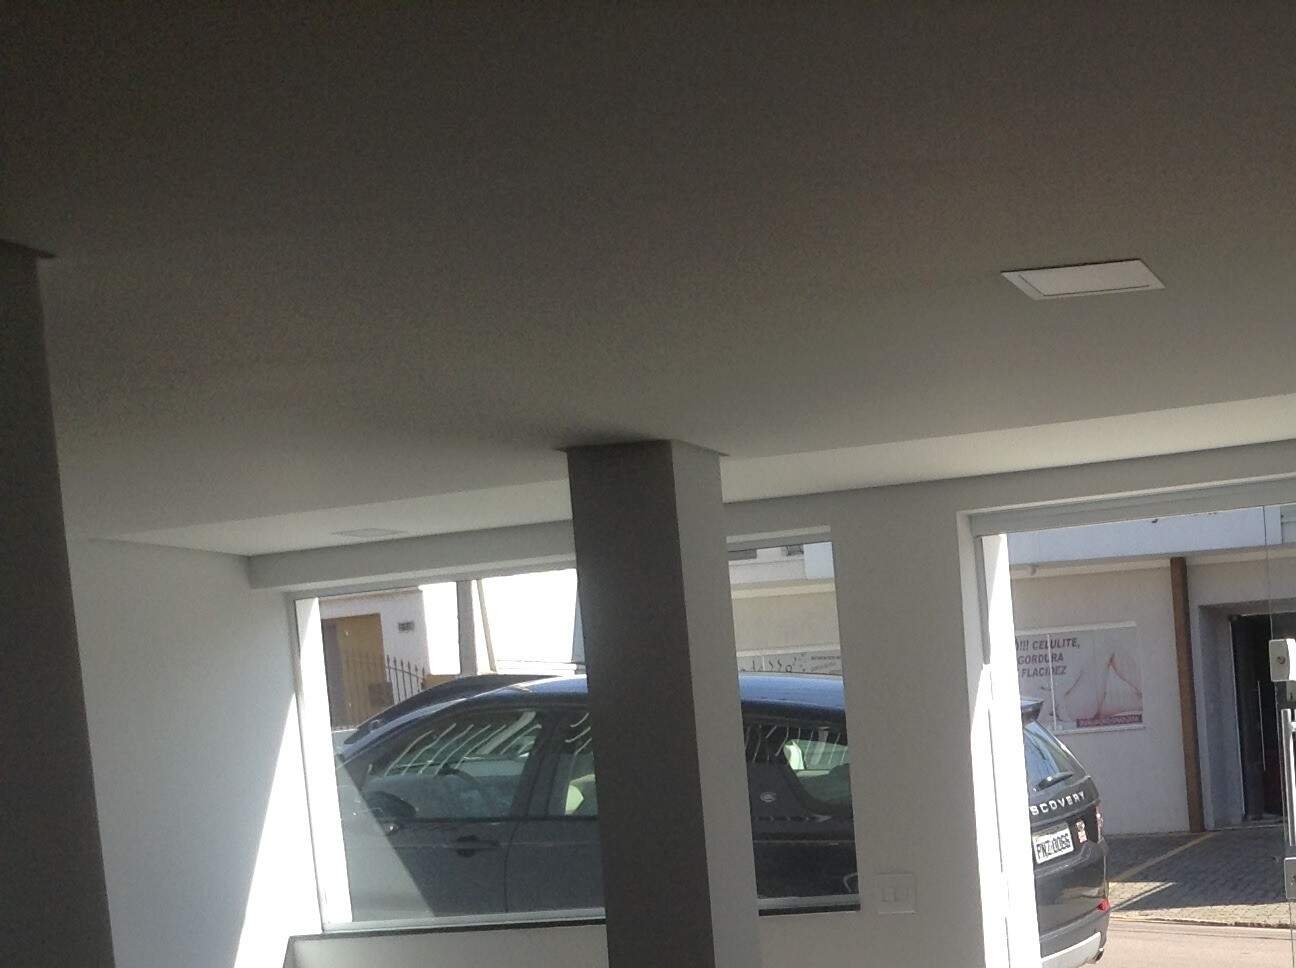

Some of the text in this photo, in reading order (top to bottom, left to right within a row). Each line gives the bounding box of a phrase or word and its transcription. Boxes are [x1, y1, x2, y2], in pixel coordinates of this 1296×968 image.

[1032, 637, 1081, 651] CELULITE,
[1017, 652, 1065, 665] GORDURA
[1021, 665, 1067, 678] FLACIDEZ
